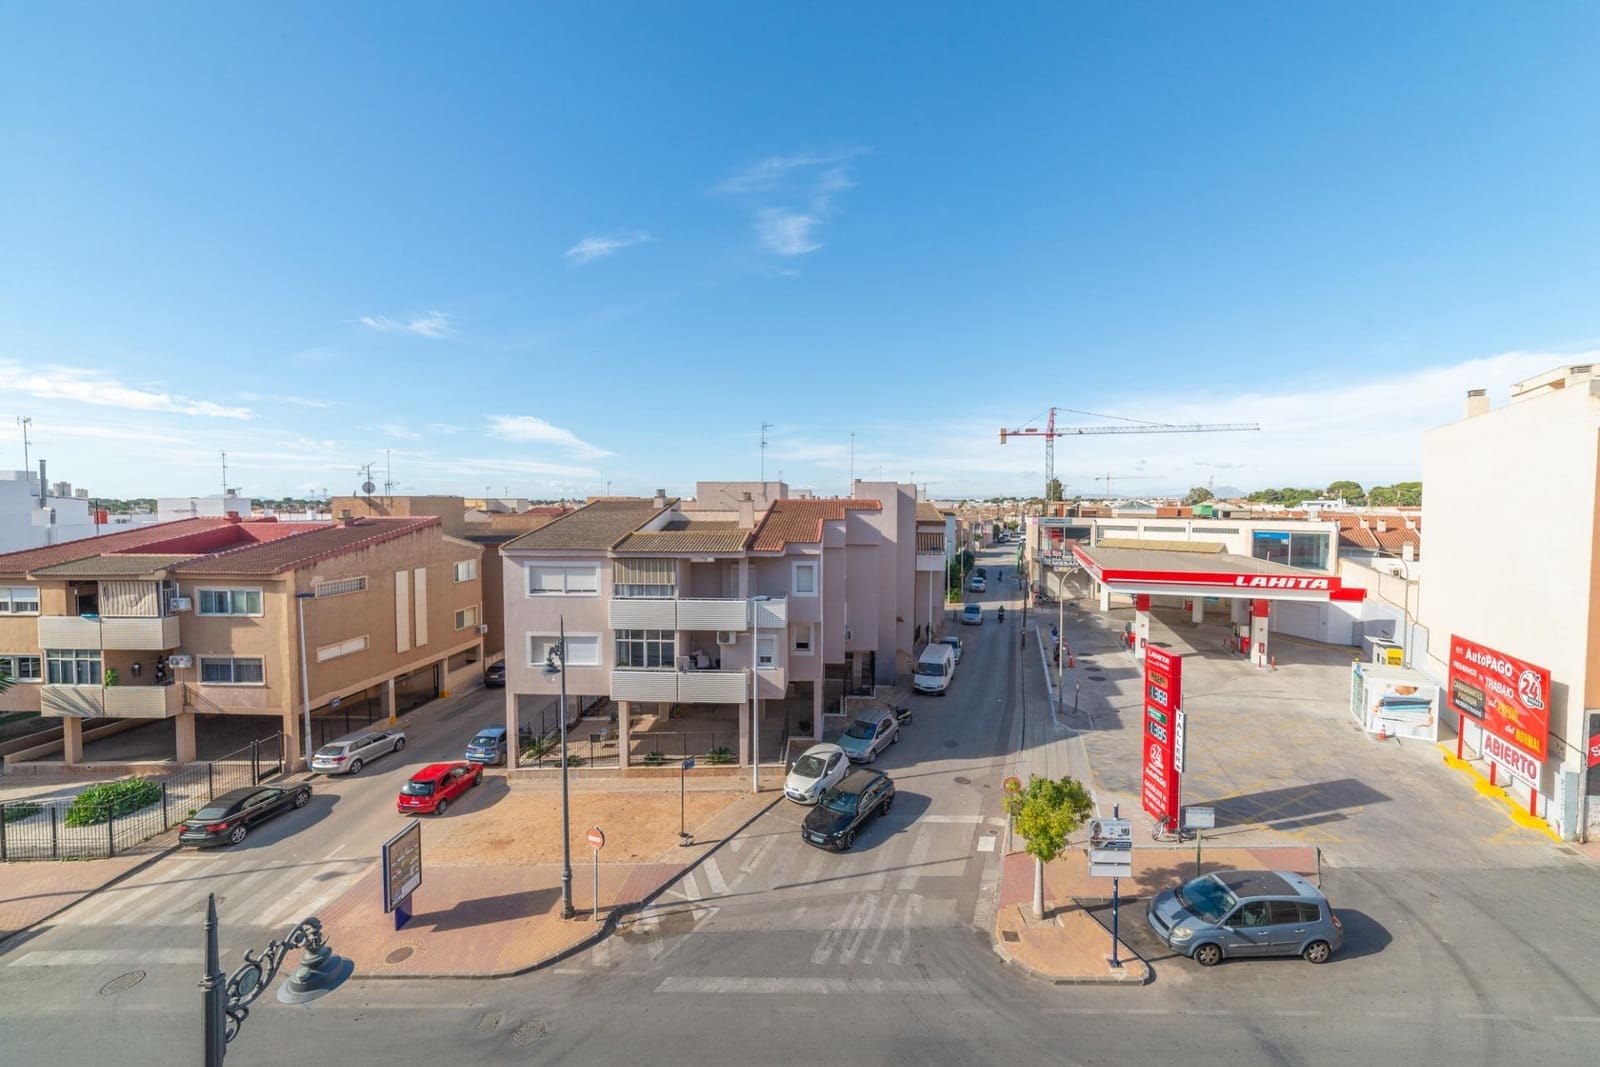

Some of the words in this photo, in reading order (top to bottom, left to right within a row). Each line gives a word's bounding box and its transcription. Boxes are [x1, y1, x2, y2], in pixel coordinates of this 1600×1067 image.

[1235, 575, 1329, 589] LAHITA
[1465, 647, 1513, 678] AutoPAGO
[1521, 677, 1539, 698] 24
[1484, 734, 1537, 780] ABIERTO
